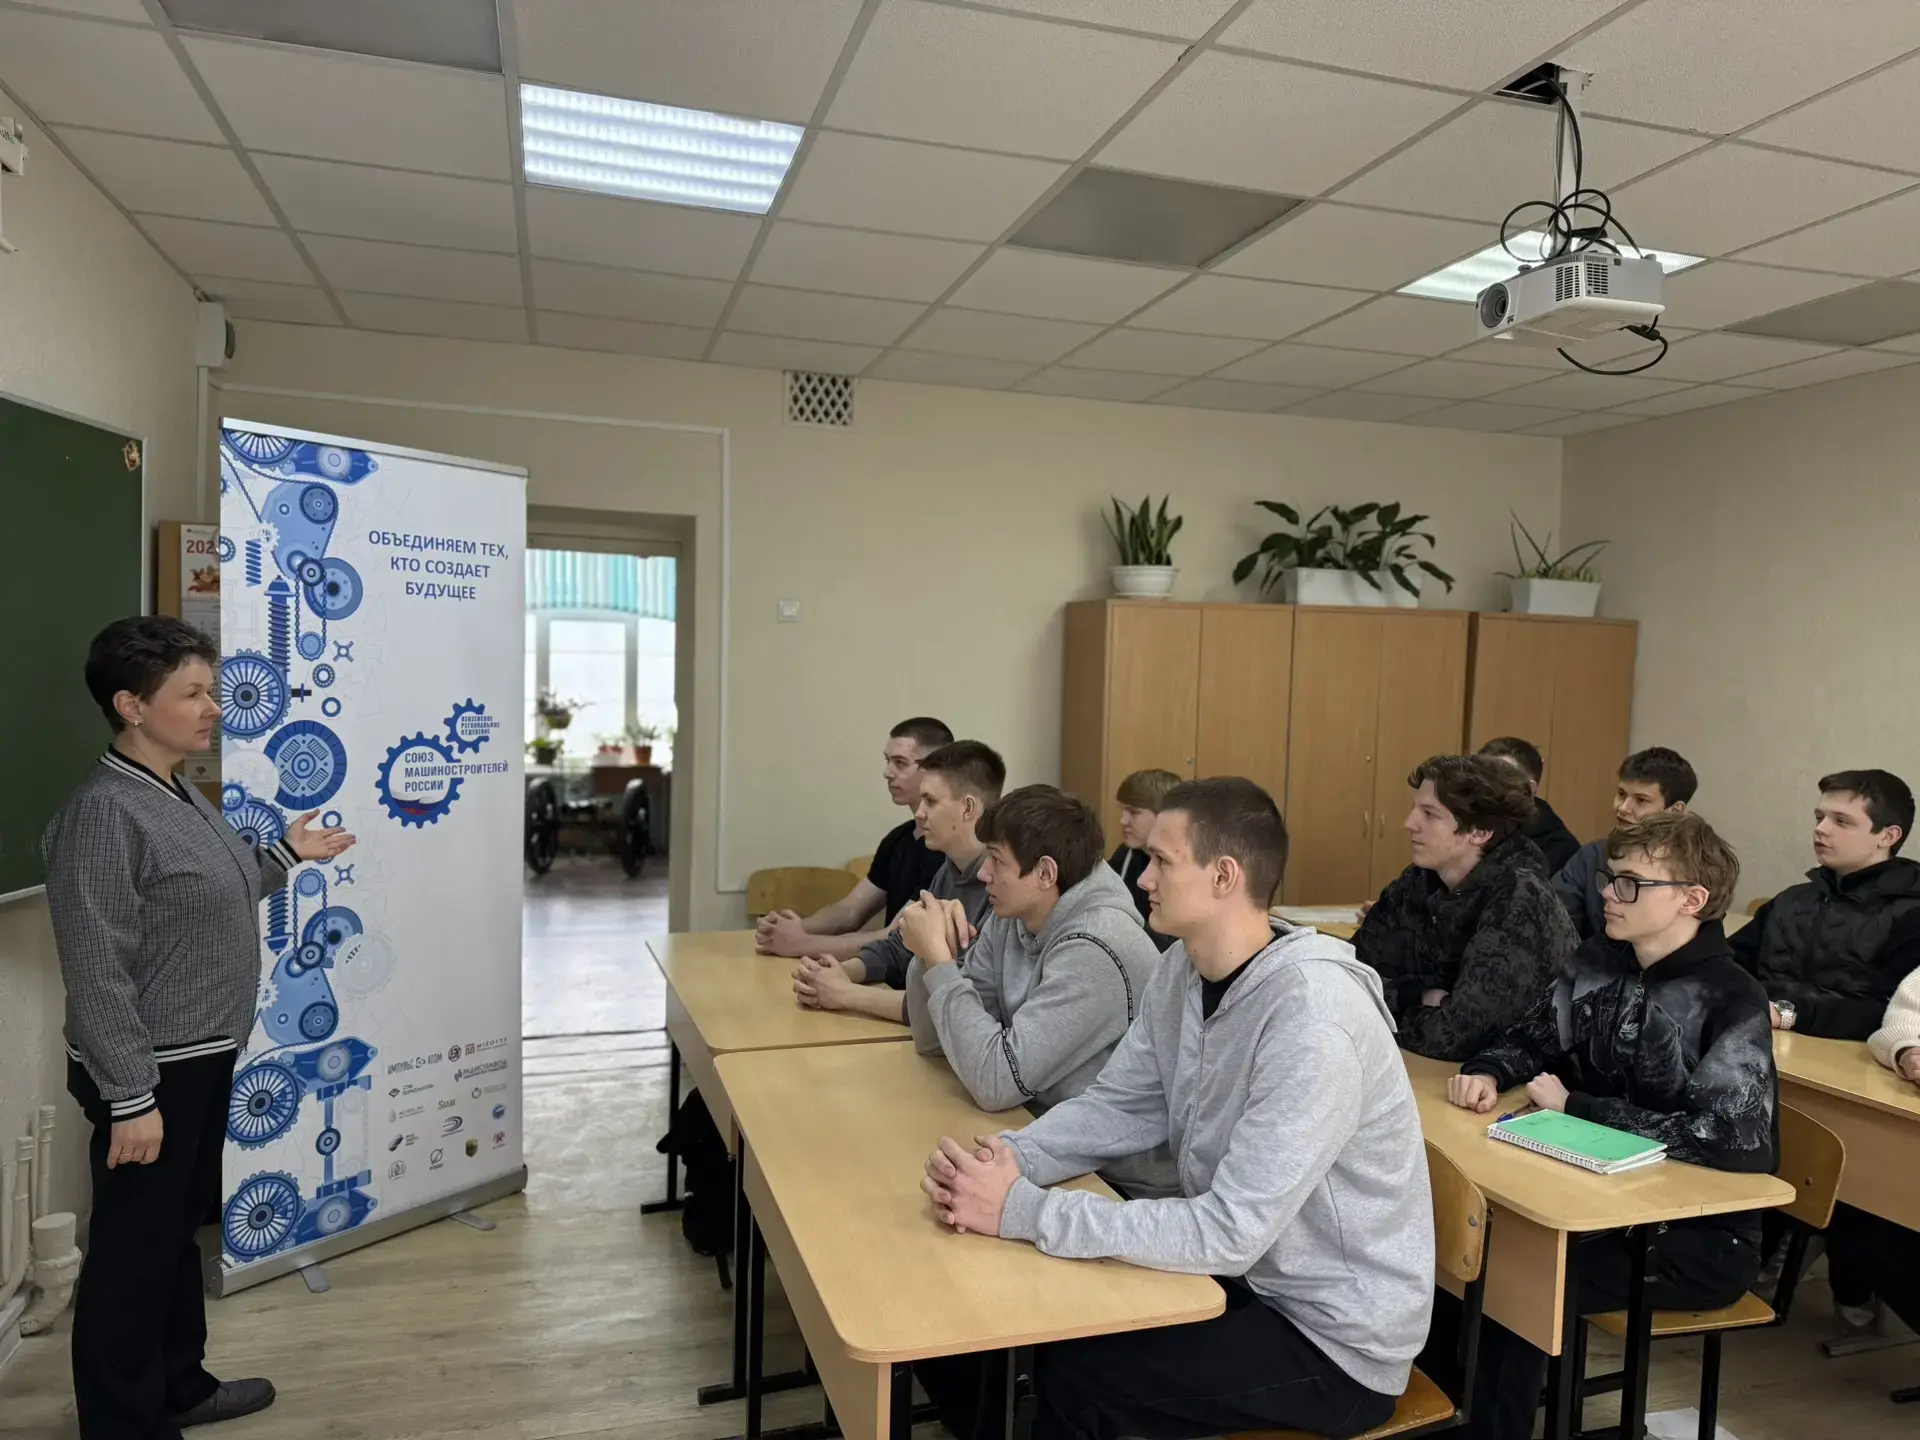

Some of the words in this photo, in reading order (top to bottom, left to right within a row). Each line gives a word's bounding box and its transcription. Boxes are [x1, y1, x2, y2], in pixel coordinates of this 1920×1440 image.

[186, 539, 216, 554] 202
[368, 530, 476, 556] ОБЪЕДИНЯЕМ
[480, 542, 509, 560] ТЕХ,
[391, 556, 421, 573] КТО
[425, 559, 491, 579] СОЗДАЕТ
[405, 581, 477, 601] БУДУЩЕЕ
[404, 752, 434, 764] СОЮЗ
[404, 760, 509, 778] МАШИНОСТРОИТЕЛЕЙ
[404, 779, 444, 792] РОССИИ
[476, 1037, 508, 1048] MIZOTTY
